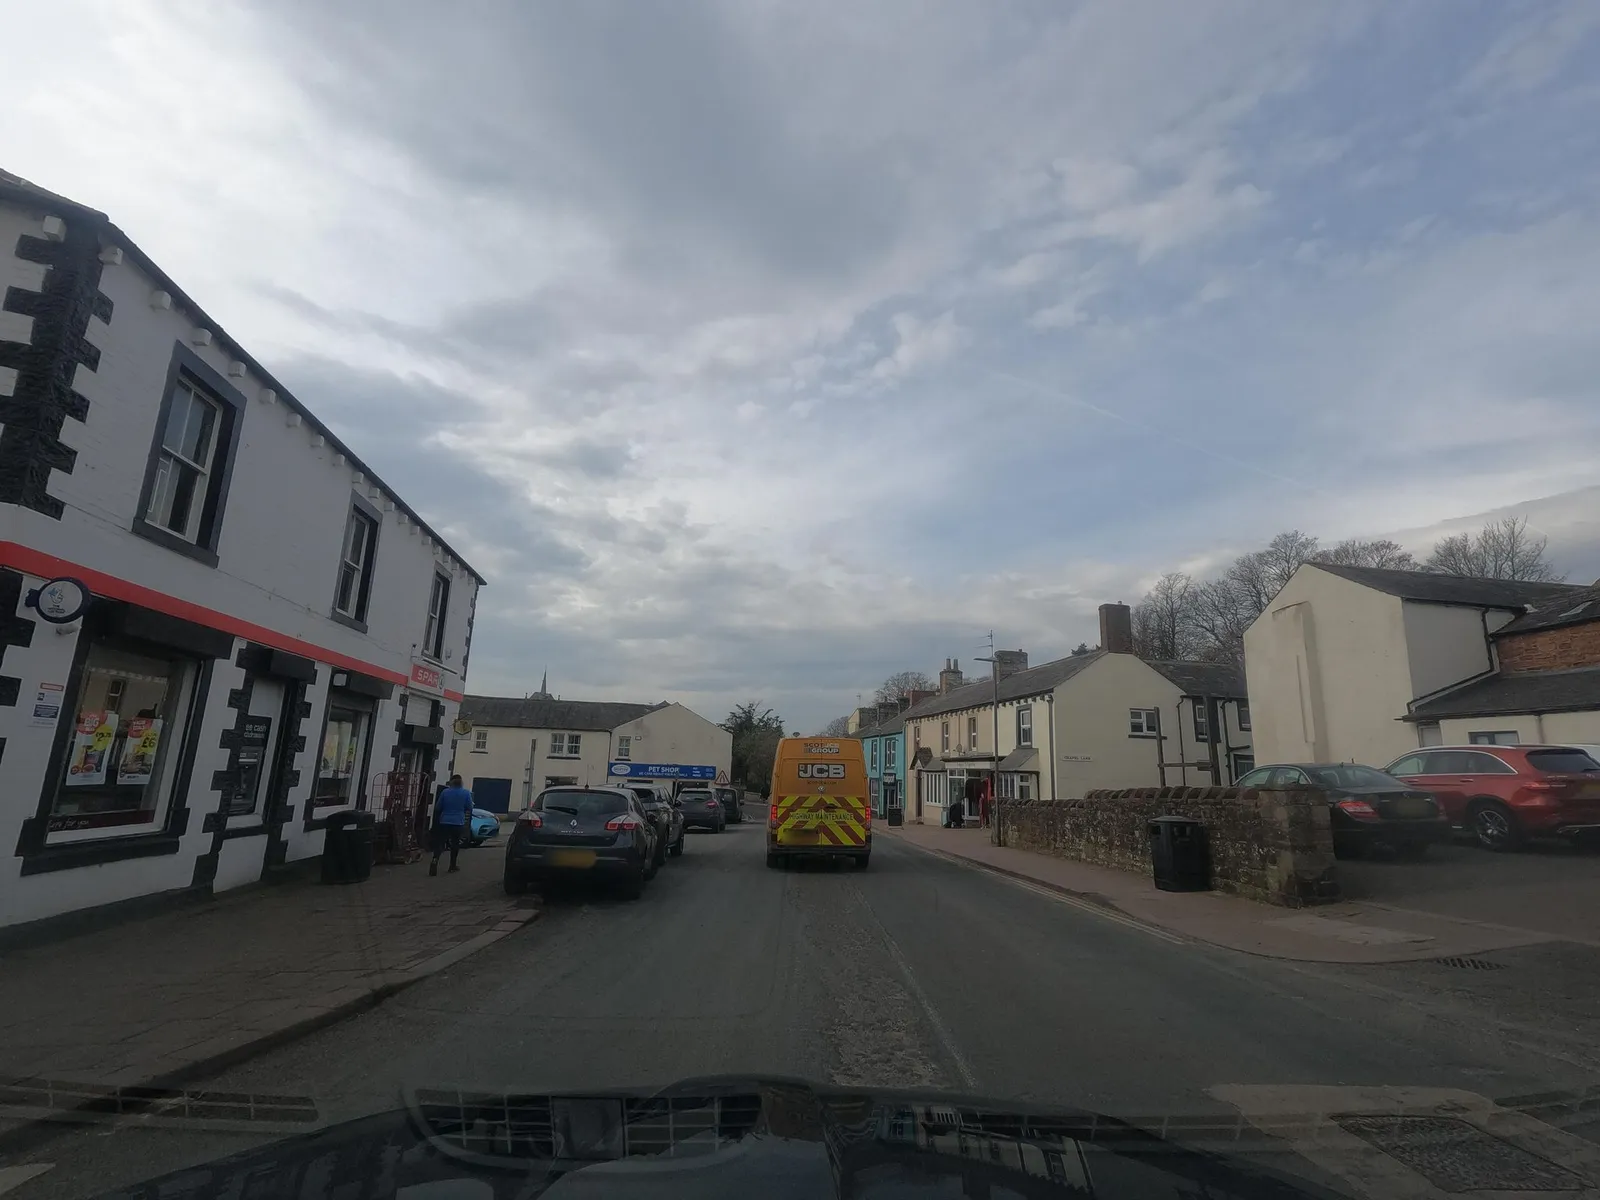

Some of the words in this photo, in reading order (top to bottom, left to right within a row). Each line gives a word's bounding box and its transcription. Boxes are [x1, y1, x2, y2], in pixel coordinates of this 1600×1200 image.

[417, 669, 438, 685] SPAR
[253, 723, 267, 732] cash
[799, 764, 845, 778] JCB
[790, 812, 814, 820] HIGHWAY
[815, 812, 854, 820] MAINTENANCE
